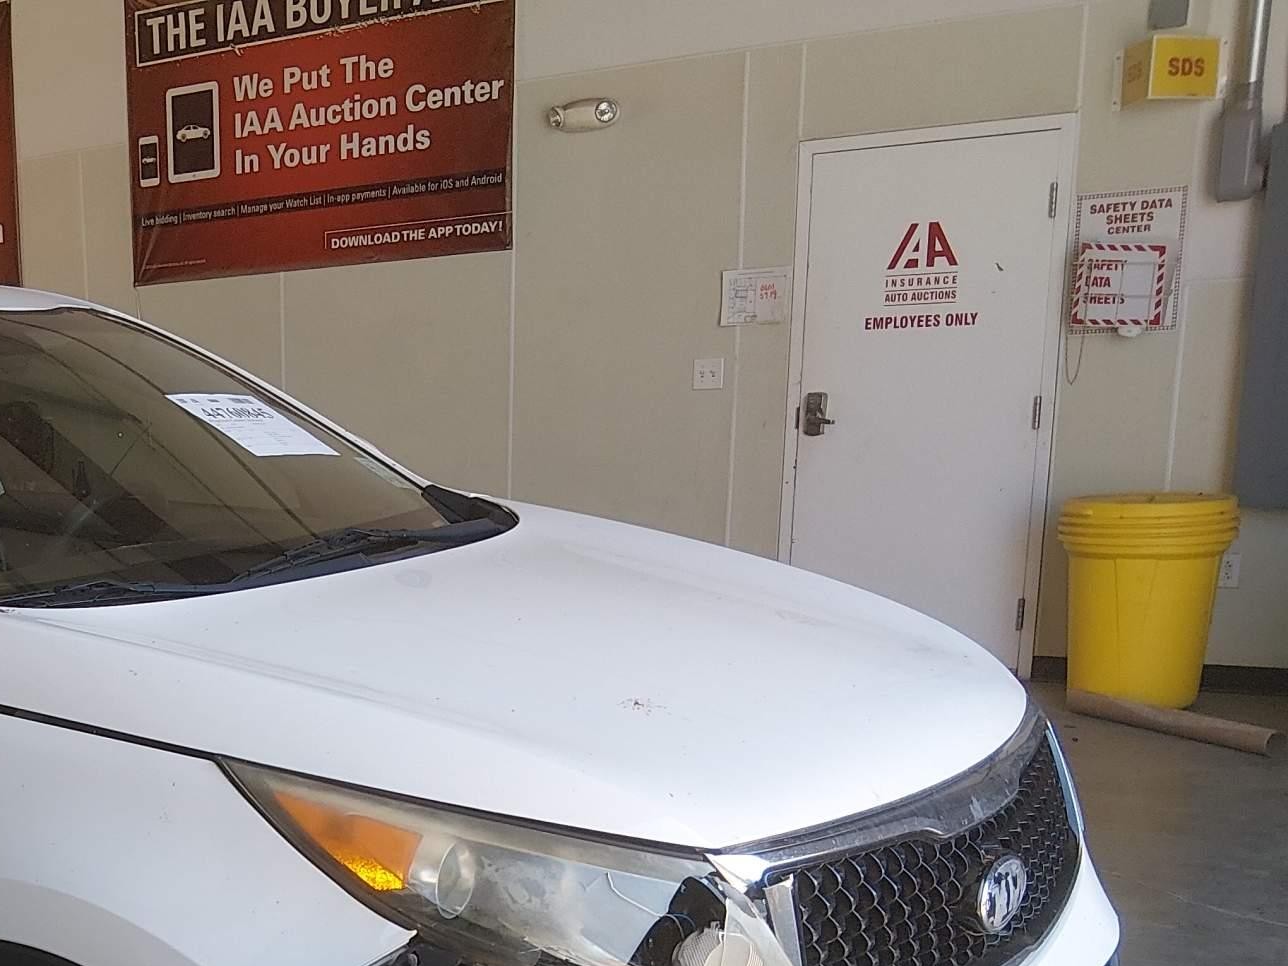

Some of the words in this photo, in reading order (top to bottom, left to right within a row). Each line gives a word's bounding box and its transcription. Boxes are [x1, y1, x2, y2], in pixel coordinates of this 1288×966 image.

[146, 9, 205, 54] THE
[217, 0, 275, 42] IAA
[1168, 57, 1205, 77] SDS
[233, 73, 273, 101] We
[284, 64, 330, 94] Put
[340, 55, 394, 84] The
[234, 108, 283, 138] IAA
[289, 94, 396, 130] Auction
[406, 79, 505, 112] Center
[235, 149, 259, 174] In
[267, 142, 330, 169] Your
[340, 125, 431, 160] Hands
[141, 216, 154, 227] Live
[183, 211, 212, 221] Inventory
[213, 207, 235, 218] search
[240, 204, 267, 214] Manage
[269, 202, 284, 212] your
[285, 197, 308, 209] Watch
[309, 196, 322, 206] List
[352, 189, 386, 201] payments
[392, 184, 426, 196] Available
[427, 181, 439, 191] for
[440, 178, 453, 189] iOS
[455, 176, 469, 188] and
[471, 173, 502, 186] Android
[1090, 201, 1137, 214] SAFETY
[1141, 198, 1173, 210] DATA
[1106, 212, 1154, 225] SHEETS
[331, 232, 401, 249] DOWNLOAD
[402, 228, 425, 242] THE
[428, 226, 453, 240] APP
[455, 220, 503, 236] TODAY!
[1107, 224, 1151, 235] CENTER
[885, 275, 958, 288] INSURANCE
[885, 293, 908, 303] AUTO
[911, 290, 956, 302] AUCTIONS
[864, 314, 940, 330] EMPLOYEES
[945, 312, 978, 327] ONLY
